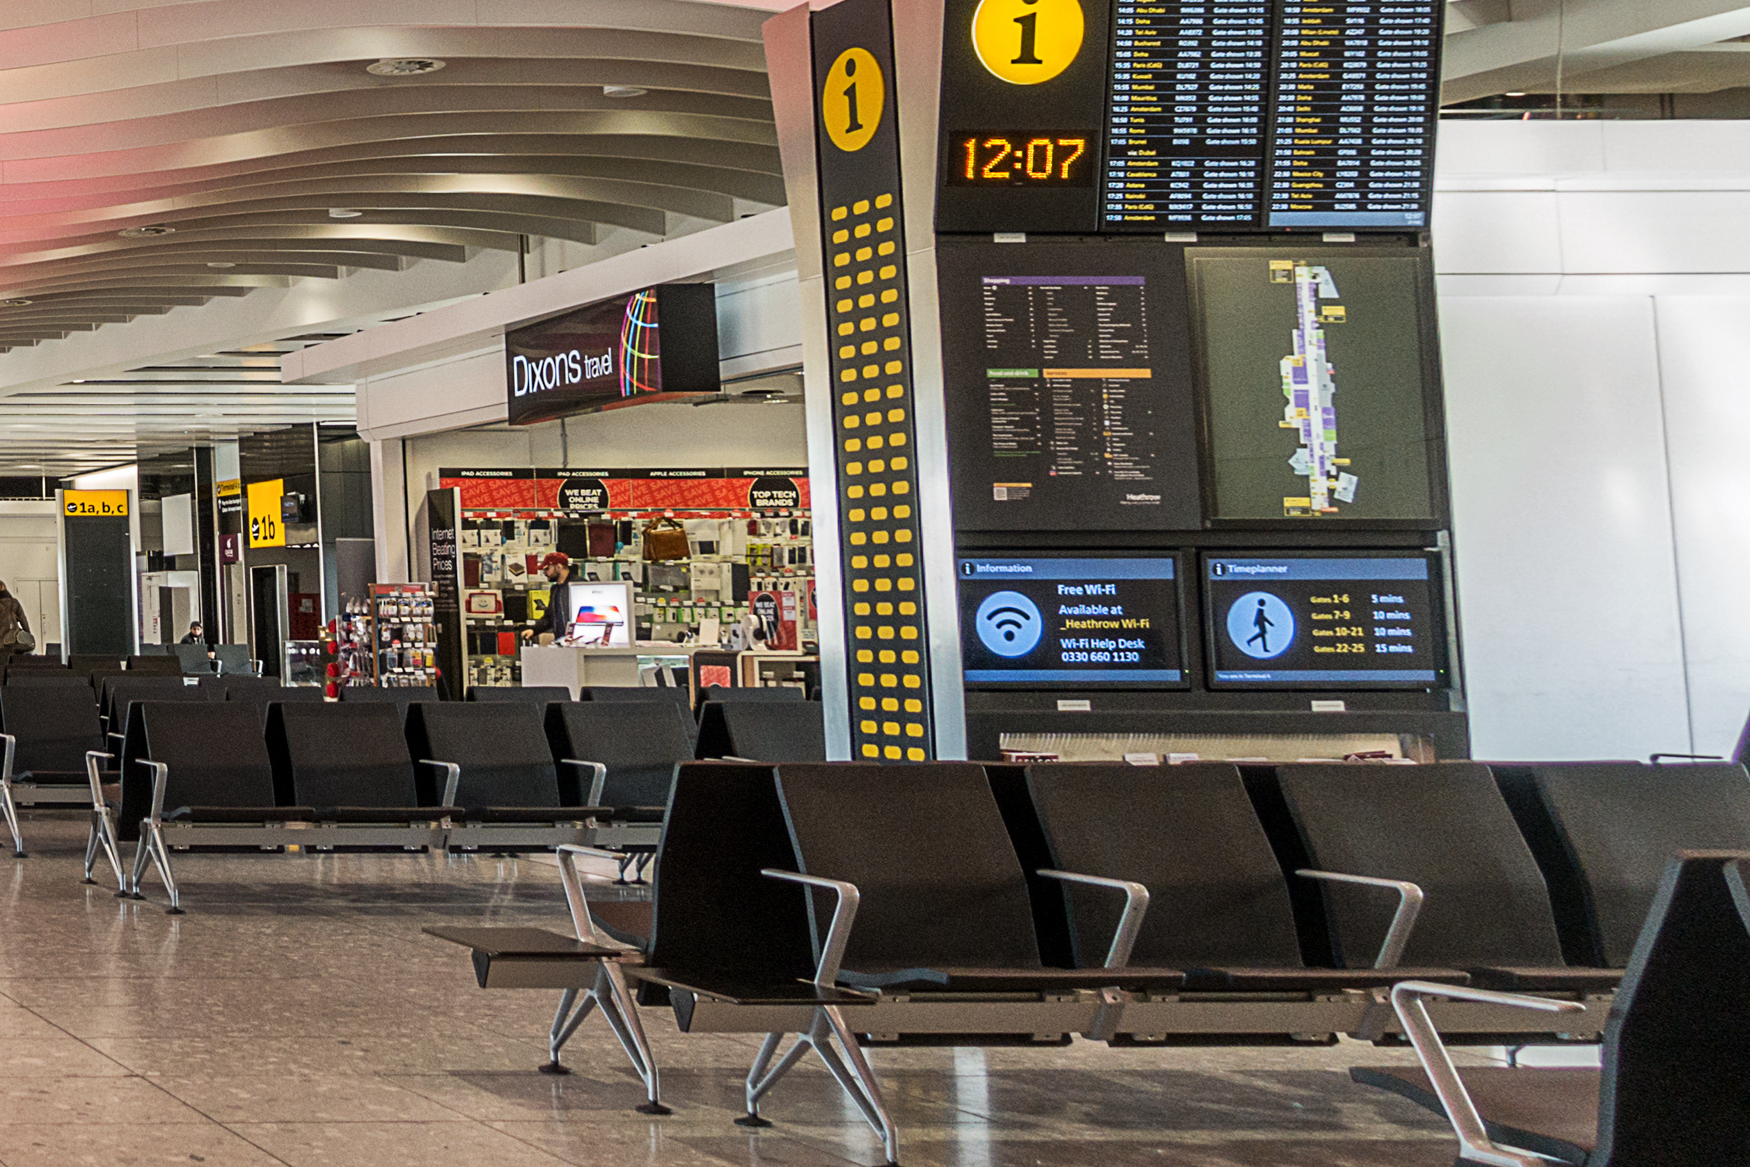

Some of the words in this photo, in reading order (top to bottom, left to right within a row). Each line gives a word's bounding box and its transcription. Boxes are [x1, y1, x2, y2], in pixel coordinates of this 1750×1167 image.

[964, 138, 1086, 179] 12:07
[983, 277, 1010, 285] Shopping
[584, 347, 613, 379] travel
[752, 491, 771, 499] TOP
[1125, 493, 1162, 501] Heathrow
[756, 499, 794, 507] BRANDS
[117, 504, 124, 514] c
[261, 513, 276, 541] 1b
[431, 527, 454, 540] Internet
[432, 542, 456, 558] Beating
[432, 558, 453, 571] Prices
[976, 563, 1033, 574] Information
[1227, 564, 1288, 575] Timeplanner
[1057, 584, 1084, 595] Free
[1084, 584, 1117, 595] Wi-Fi
[1310, 596, 1332, 604] Gates
[1332, 594, 1350, 603] 1-6
[1371, 594, 1379, 603] 5
[1379, 594, 1404, 604] mins
[1058, 604, 1109, 615] Available
[1110, 605, 1122, 615] at
[1311, 612, 1333, 620] Gates
[1334, 610, 1351, 620] 7-9
[1372, 610, 1385, 620] 10
[1386, 611, 1411, 620] mins
[1059, 619, 1120, 630] _Heathrow
[1121, 619, 1150, 629] Wi-Fi
[1334, 627, 1364, 636] 10-21
[1374, 627, 1386, 636] 10
[1387, 627, 1412, 637] mins
[1060, 638, 1090, 649] Wi-Fi
[1090, 638, 1117, 651] Help
[1117, 638, 1145, 649] Desk
[1335, 644, 1365, 653] 22-25
[1375, 644, 1387, 653] 15
[1388, 644, 1413, 653] mins
[1061, 651, 1089, 662] 0330
[1089, 651, 1111, 662] 660
[1112, 651, 1140, 662] 1130
